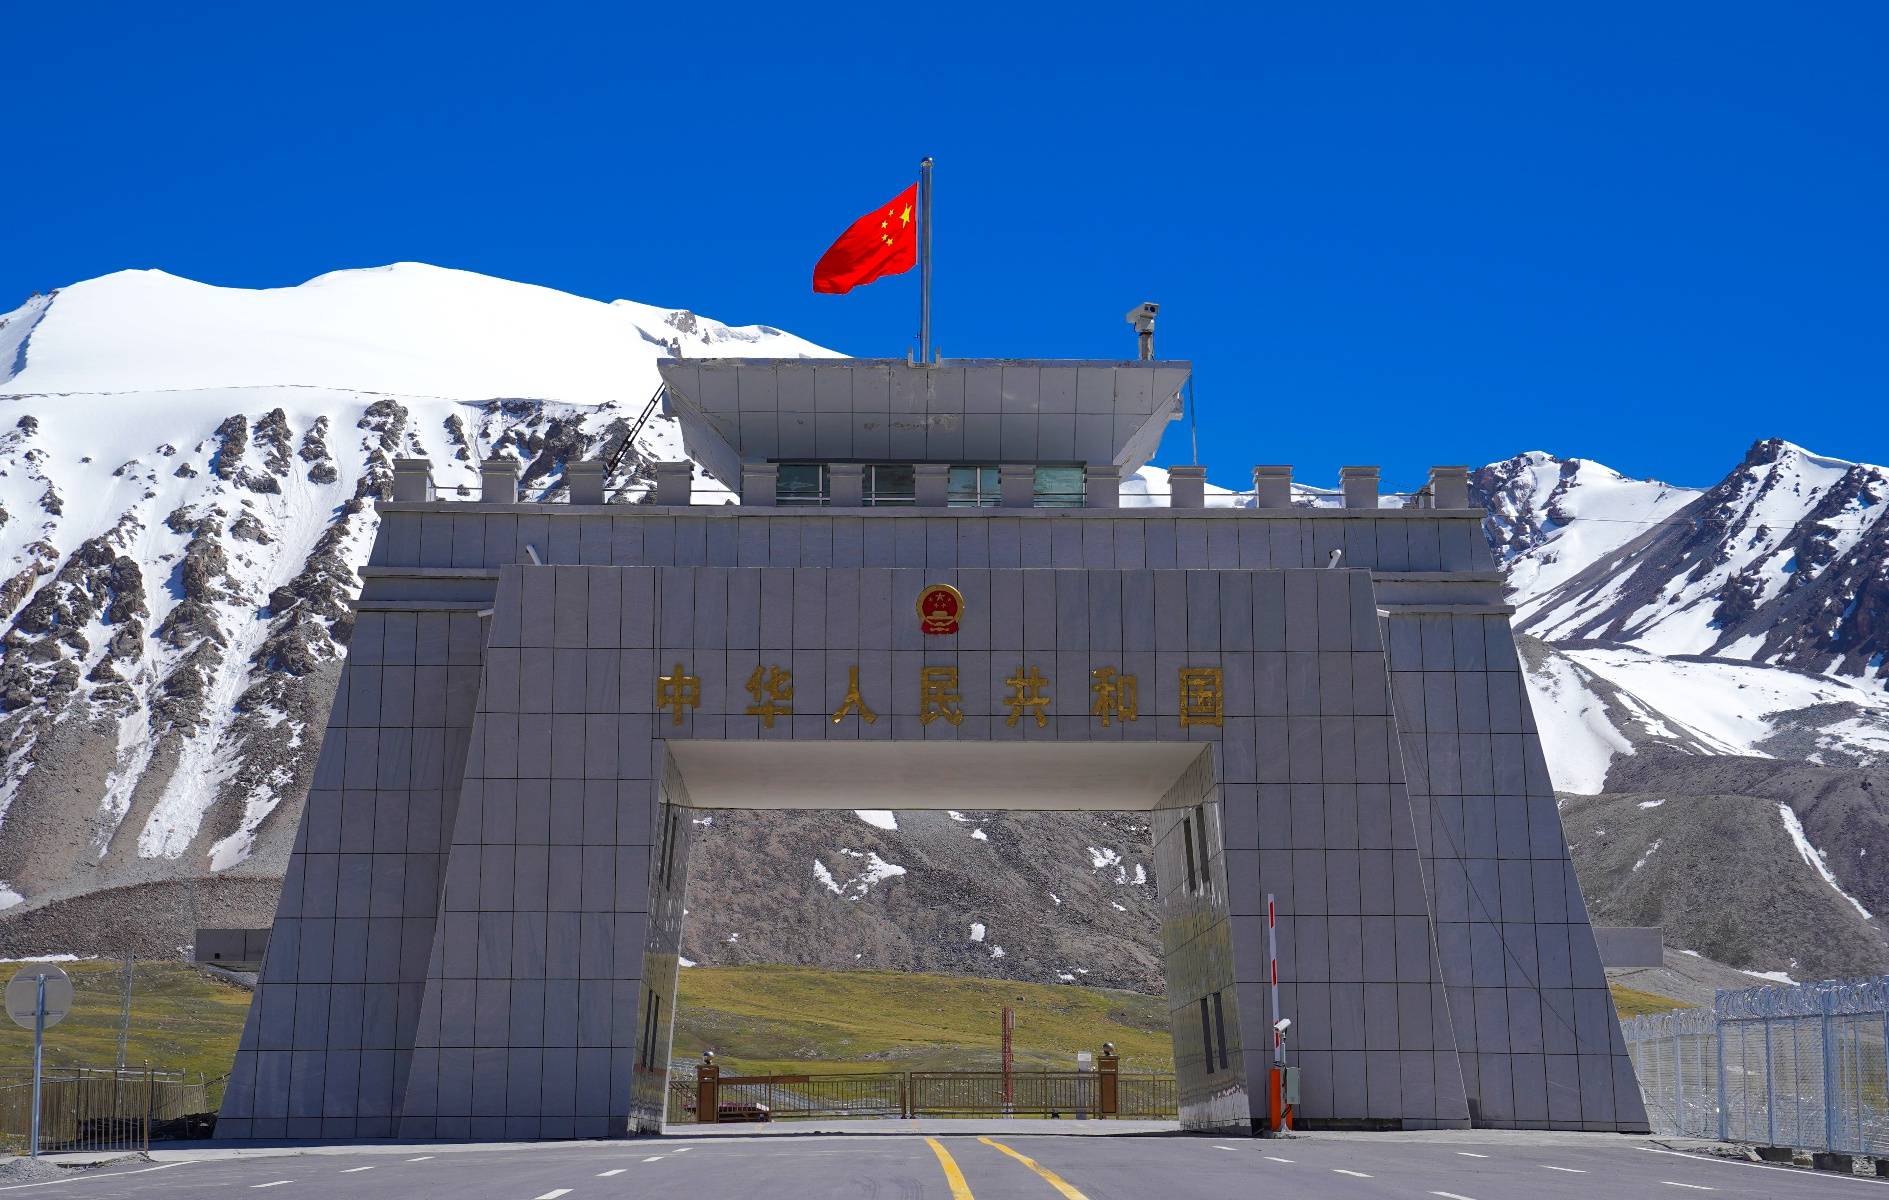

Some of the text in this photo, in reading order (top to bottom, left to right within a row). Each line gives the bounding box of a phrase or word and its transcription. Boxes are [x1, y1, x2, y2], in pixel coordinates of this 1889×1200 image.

[656, 663, 1224, 728] 中华人民共和国
